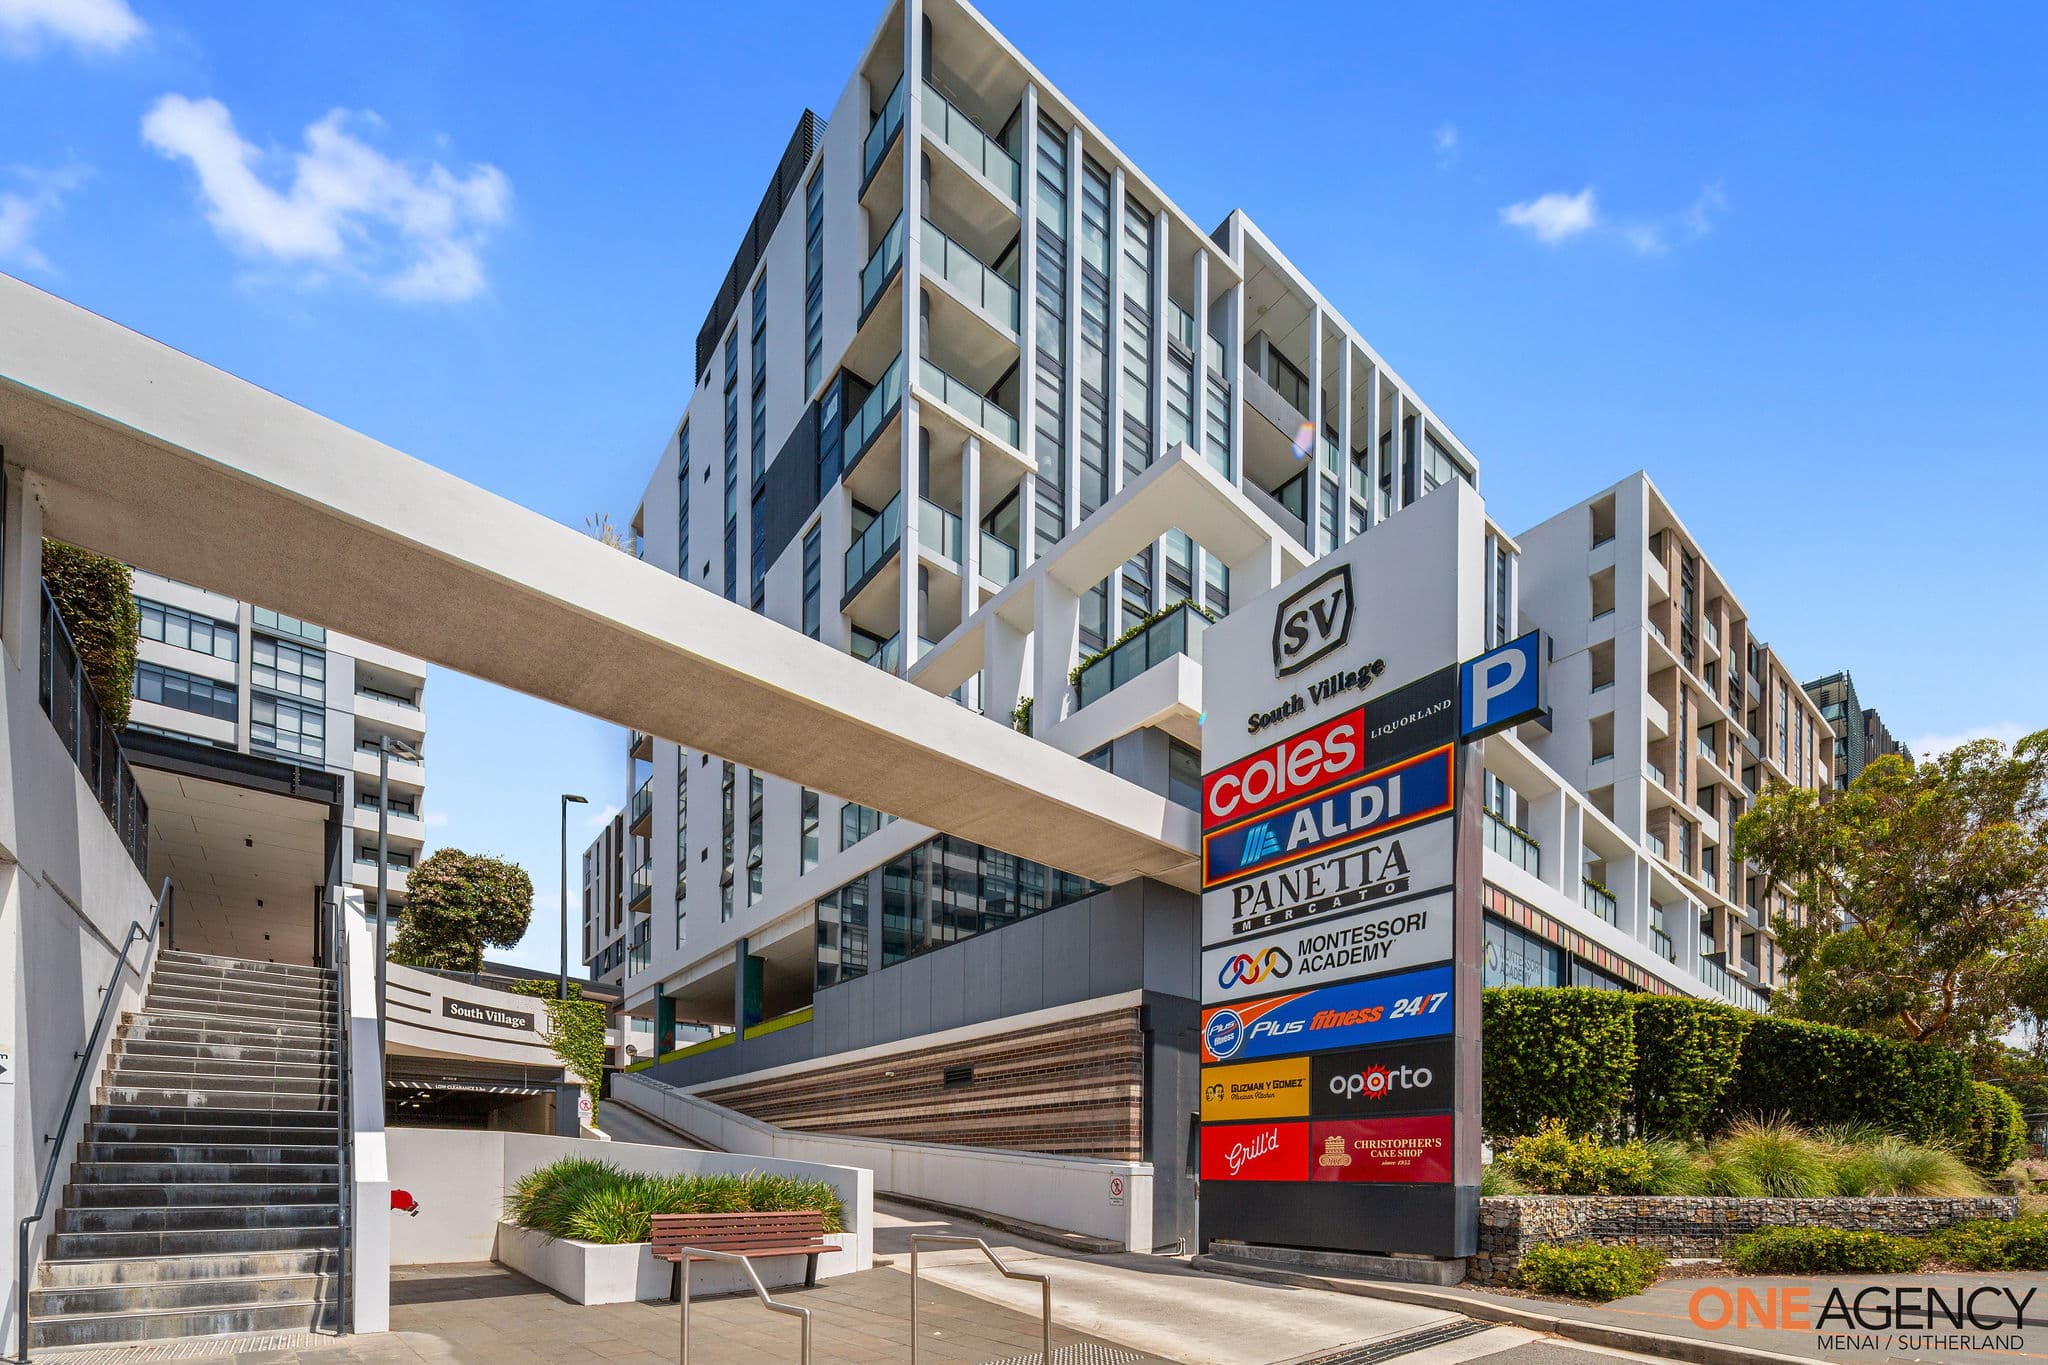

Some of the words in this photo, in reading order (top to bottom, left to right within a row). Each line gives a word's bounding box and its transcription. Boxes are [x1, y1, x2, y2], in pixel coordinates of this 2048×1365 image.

[1284, 588, 1343, 656] SV
[1248, 694, 1305, 735] South
[1307, 658, 1386, 705] Village
[1472, 648, 1527, 728] P
[1371, 699, 1452, 740] LIQUORLAND
[1209, 724, 1356, 816] coles
[1287, 775, 1401, 851] ALDI
[1232, 839, 1410, 919] PANETTA
[1242, 883, 1396, 931] MERCATO
[1298, 911, 1427, 956] MONTESSORI
[1298, 940, 1393, 975] ACADEMY
[450, 1003, 484, 1020] South
[485, 1010, 526, 1028] Village
[1250, 1020, 1306, 1039] Plus
[1309, 1005, 1384, 1030] fitness
[1389, 992, 1448, 1019] 24/7
[1231, 1082, 1264, 1093] GUZMAN
[1266, 1081, 1271, 1090] Y
[1273, 1079, 1303, 1089] GOMEZ
[1329, 1065, 1433, 1099] oporto
[1225, 1127, 1279, 1176] Grill'd
[1354, 1138, 1442, 1149] CHRISTOPHER'S
[1370, 1149, 1396, 1158] CAKE
[1397, 1149, 1423, 1158] SHOP
